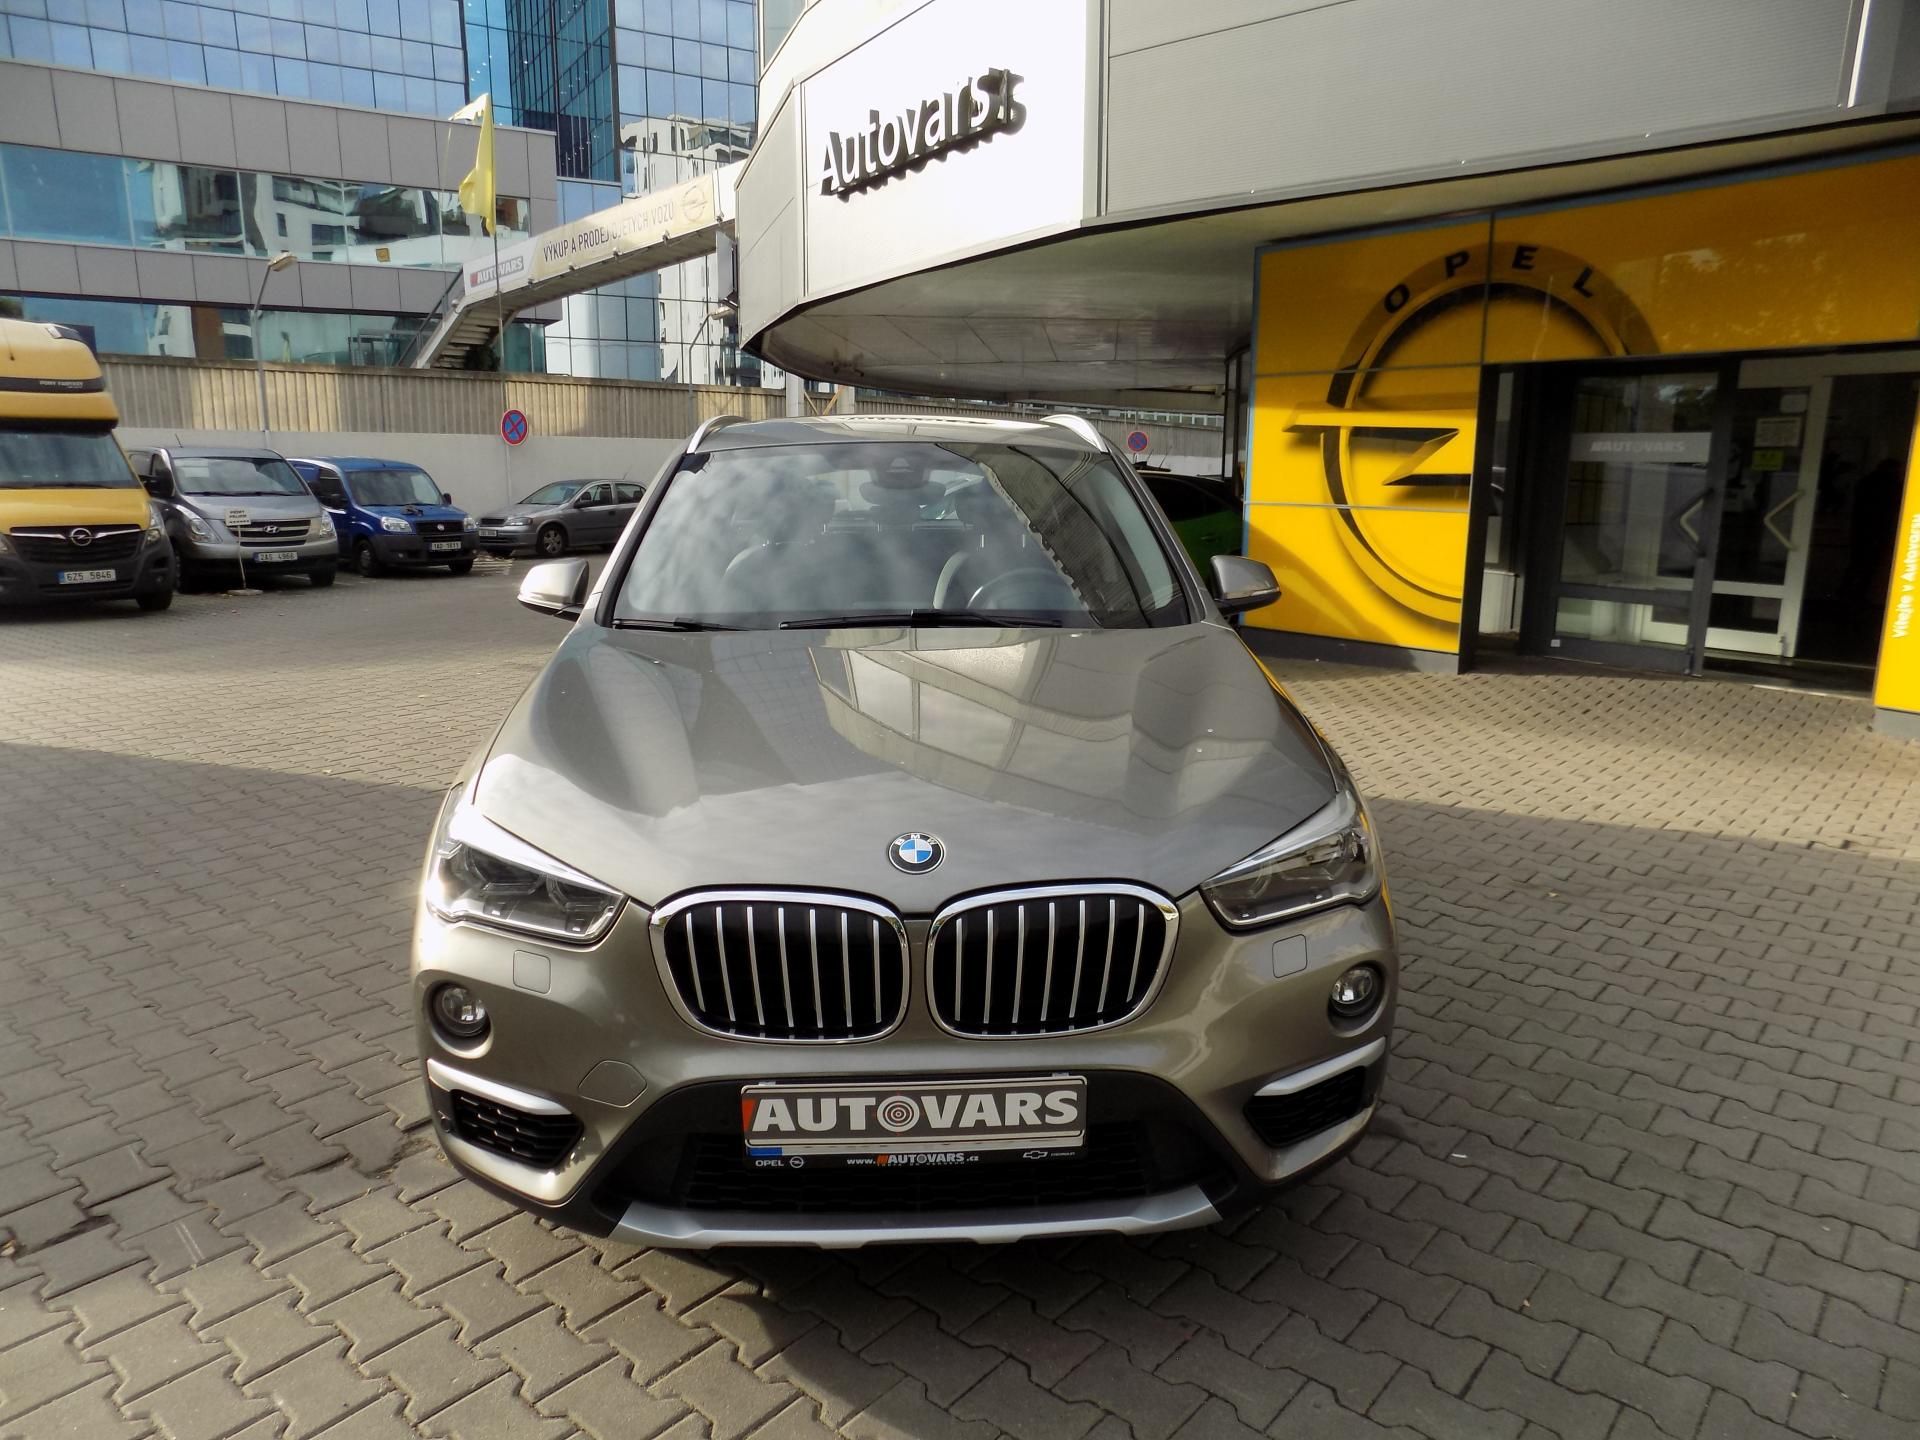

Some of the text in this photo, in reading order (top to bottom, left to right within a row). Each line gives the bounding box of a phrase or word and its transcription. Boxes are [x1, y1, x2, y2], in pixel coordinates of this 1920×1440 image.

[543, 239, 569, 262] VÝKUP
[571, 237, 578, 255] A
[578, 226, 610, 250] PRODEJ
[1384, 245, 1594, 314] OPEL
[89, 571, 112, 579] 5846
[895, 834, 938, 845] BMW
[752, 1090, 1078, 1132] AUTOVARS
[755, 1159, 785, 1168] OPEL
